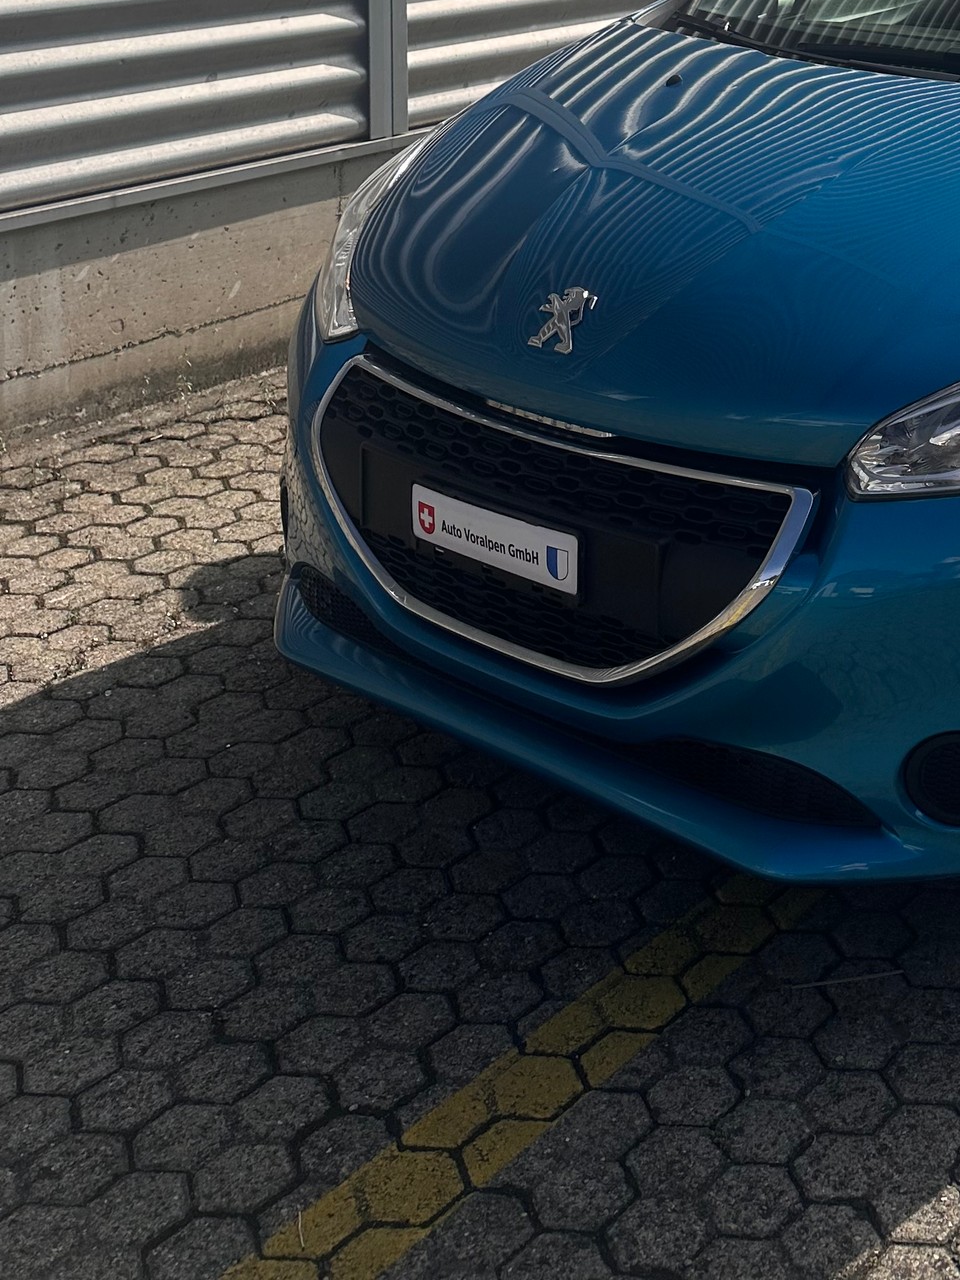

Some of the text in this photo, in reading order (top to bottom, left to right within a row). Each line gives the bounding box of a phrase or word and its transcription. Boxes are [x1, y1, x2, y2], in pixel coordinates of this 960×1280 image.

[441, 519, 539, 566] Auto Voralpen GmbH
